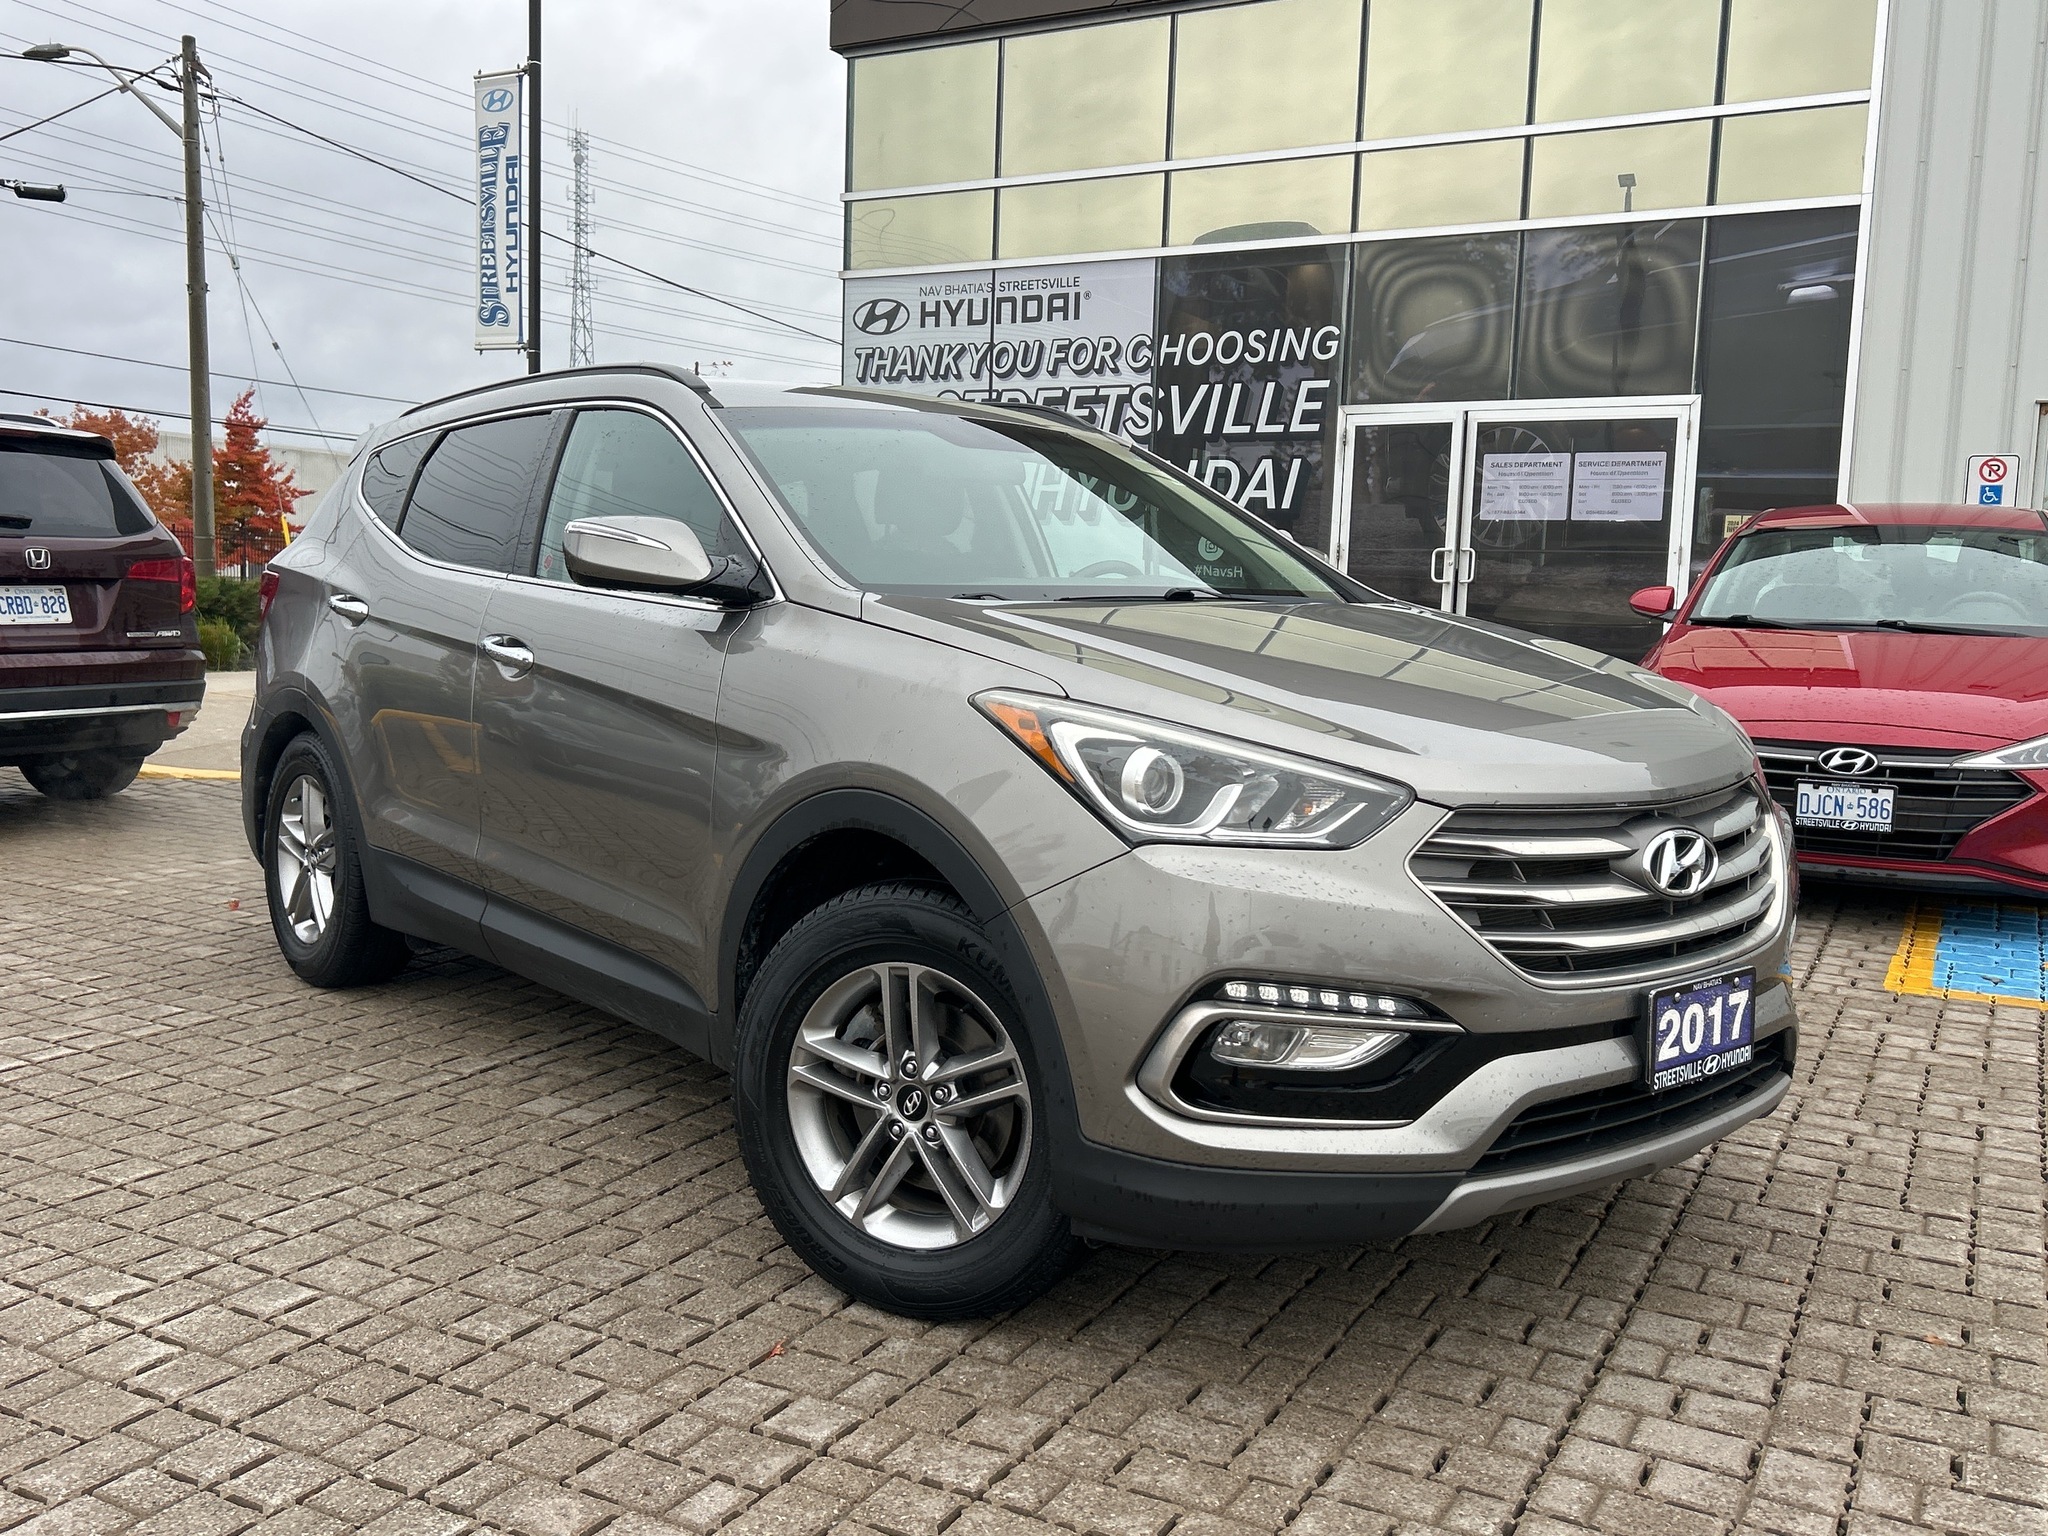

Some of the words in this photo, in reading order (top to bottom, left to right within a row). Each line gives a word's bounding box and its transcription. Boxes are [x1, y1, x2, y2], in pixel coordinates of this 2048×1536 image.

[478, 122, 511, 327] STREETSVILLE
[505, 155, 519, 293] HYUNDAI
[919, 285, 943, 297] NAV
[945, 282, 995, 296] BHATIA'S
[998, 276, 1081, 293] STREETSVILLE
[855, 343, 967, 385] THANK
[968, 339, 1044, 380] YOU
[1046, 336, 1122, 378] FOR
[1125, 325, 1342, 372] CHOOSING
[1490, 461, 1513, 469] SALES
[1578, 460, 1611, 468] SERVICE
[1826, 786, 1867, 795] ONTARIO
[1799, 792, 1845, 817] DJCN
[1857, 797, 1891, 820] 586
[1795, 817, 1841, 829] STREETSVILLE
[1859, 823, 1892, 833] HYUNDAI
[1658, 989, 1749, 1062] 2017
[1653, 1060, 1702, 1091] STREETSVILLE
[1721, 1045, 1752, 1069] HYUNDAI
